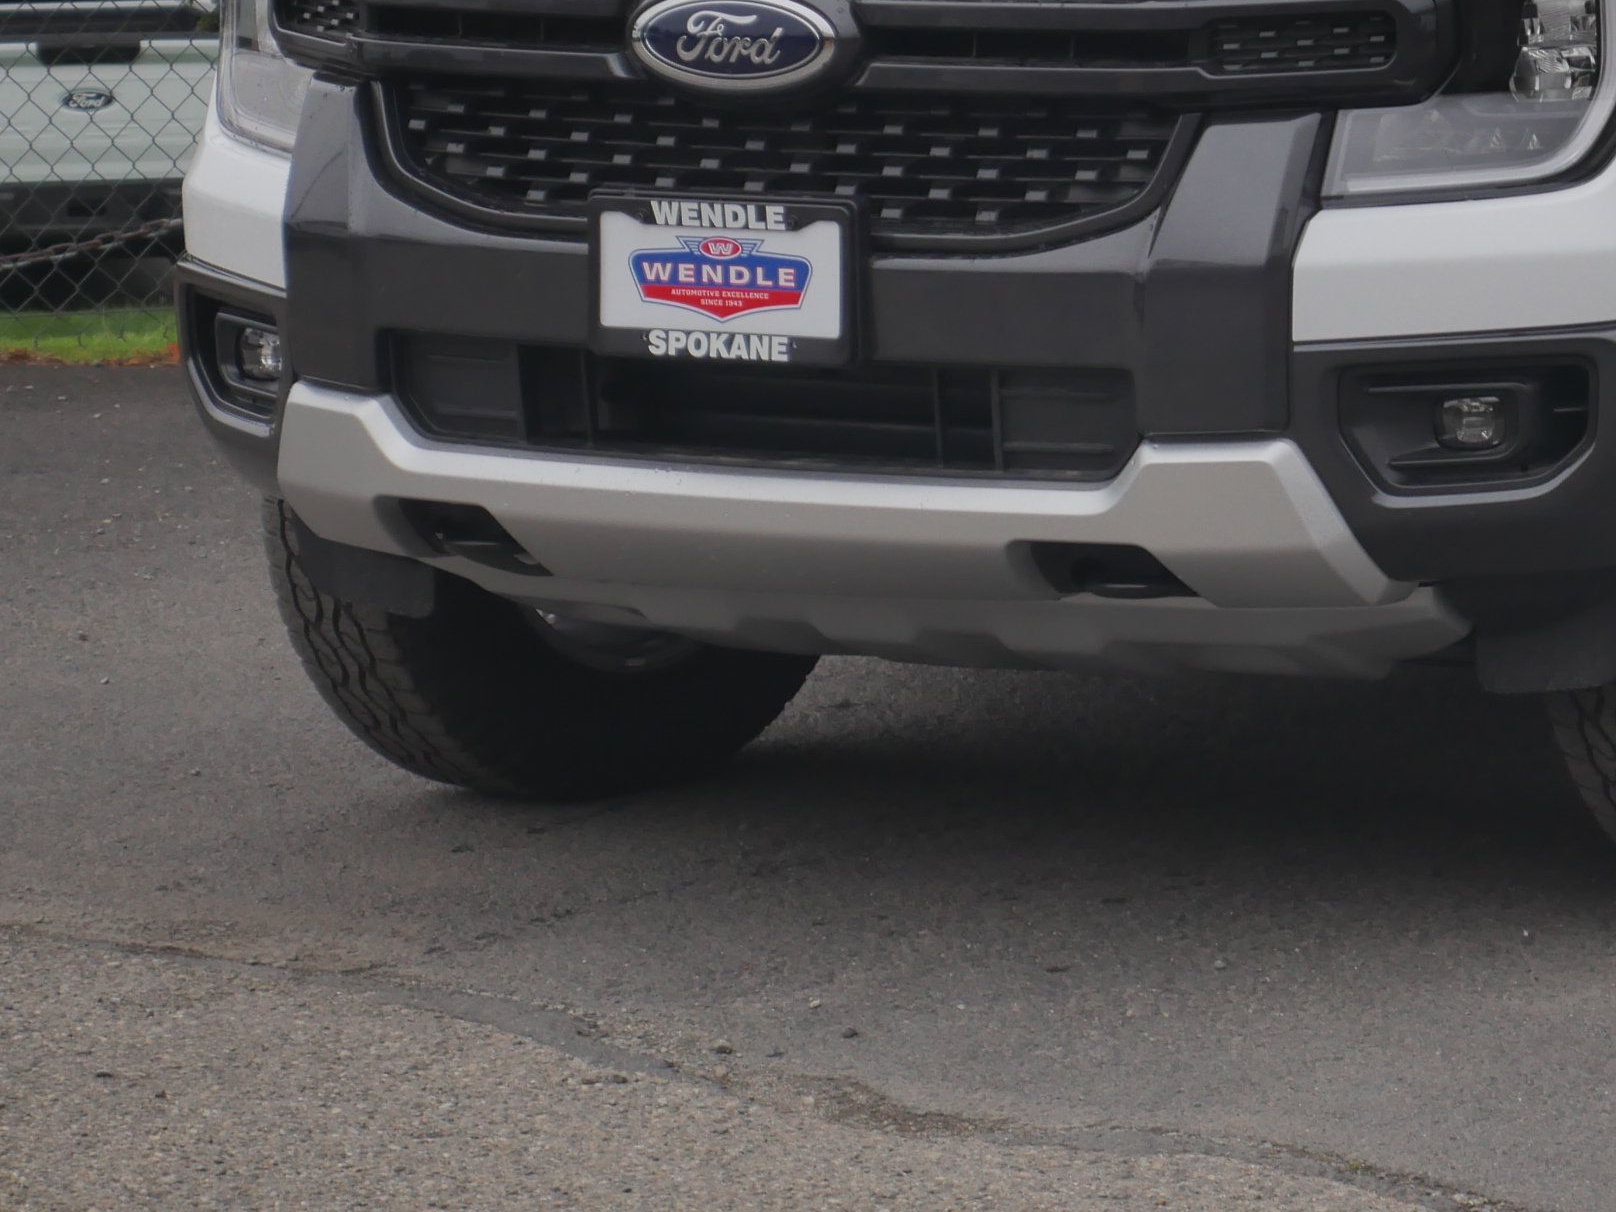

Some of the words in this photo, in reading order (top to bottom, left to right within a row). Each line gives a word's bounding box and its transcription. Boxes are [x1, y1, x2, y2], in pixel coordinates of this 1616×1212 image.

[676, 10, 784, 64] Ford
[650, 200, 786, 230] WENDLE
[641, 261, 796, 287] WENDLE
[671, 289, 720, 297] AUTOMOTIVE
[722, 290, 769, 299] EXCELLENCE
[700, 298, 723, 306] SINCE
[647, 329, 789, 362] SPOKANE
